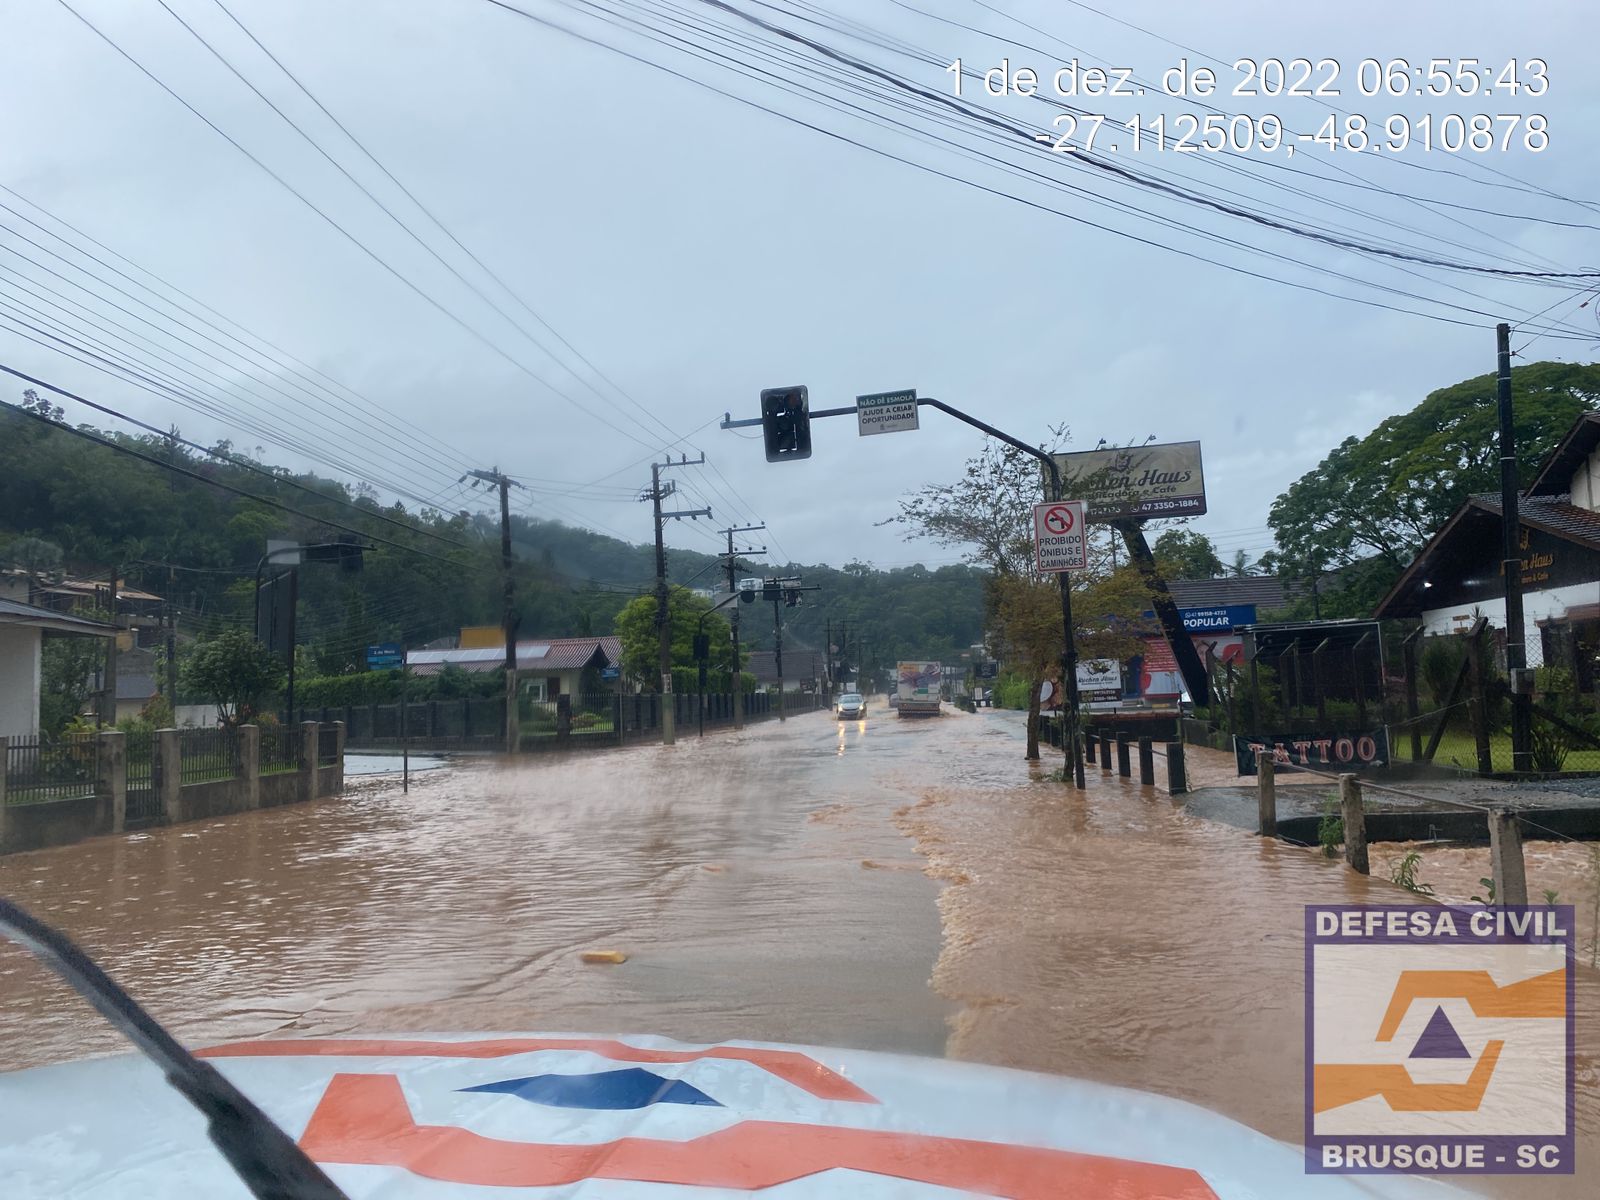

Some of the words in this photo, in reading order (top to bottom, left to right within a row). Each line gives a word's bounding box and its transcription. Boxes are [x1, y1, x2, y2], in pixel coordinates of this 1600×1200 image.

[887, 395, 913, 403] ESMOLA
[863, 408, 884, 416] AJUDE
[861, 412, 915, 424] OPORTUNIDADE
[1138, 469, 1192, 486] Haus
[1153, 485, 1177, 494] Café
[1141, 503, 1152, 511] 47
[1154, 500, 1199, 510] 3350-1884
[1040, 536, 1082, 546] PROIBIDO
[1040, 547, 1073, 557] ÔNIBUS
[1040, 557, 1083, 568] CAMINHÕES
[1183, 617, 1230, 627] POPULAR
[1248, 737, 1376, 766] TATTOO
